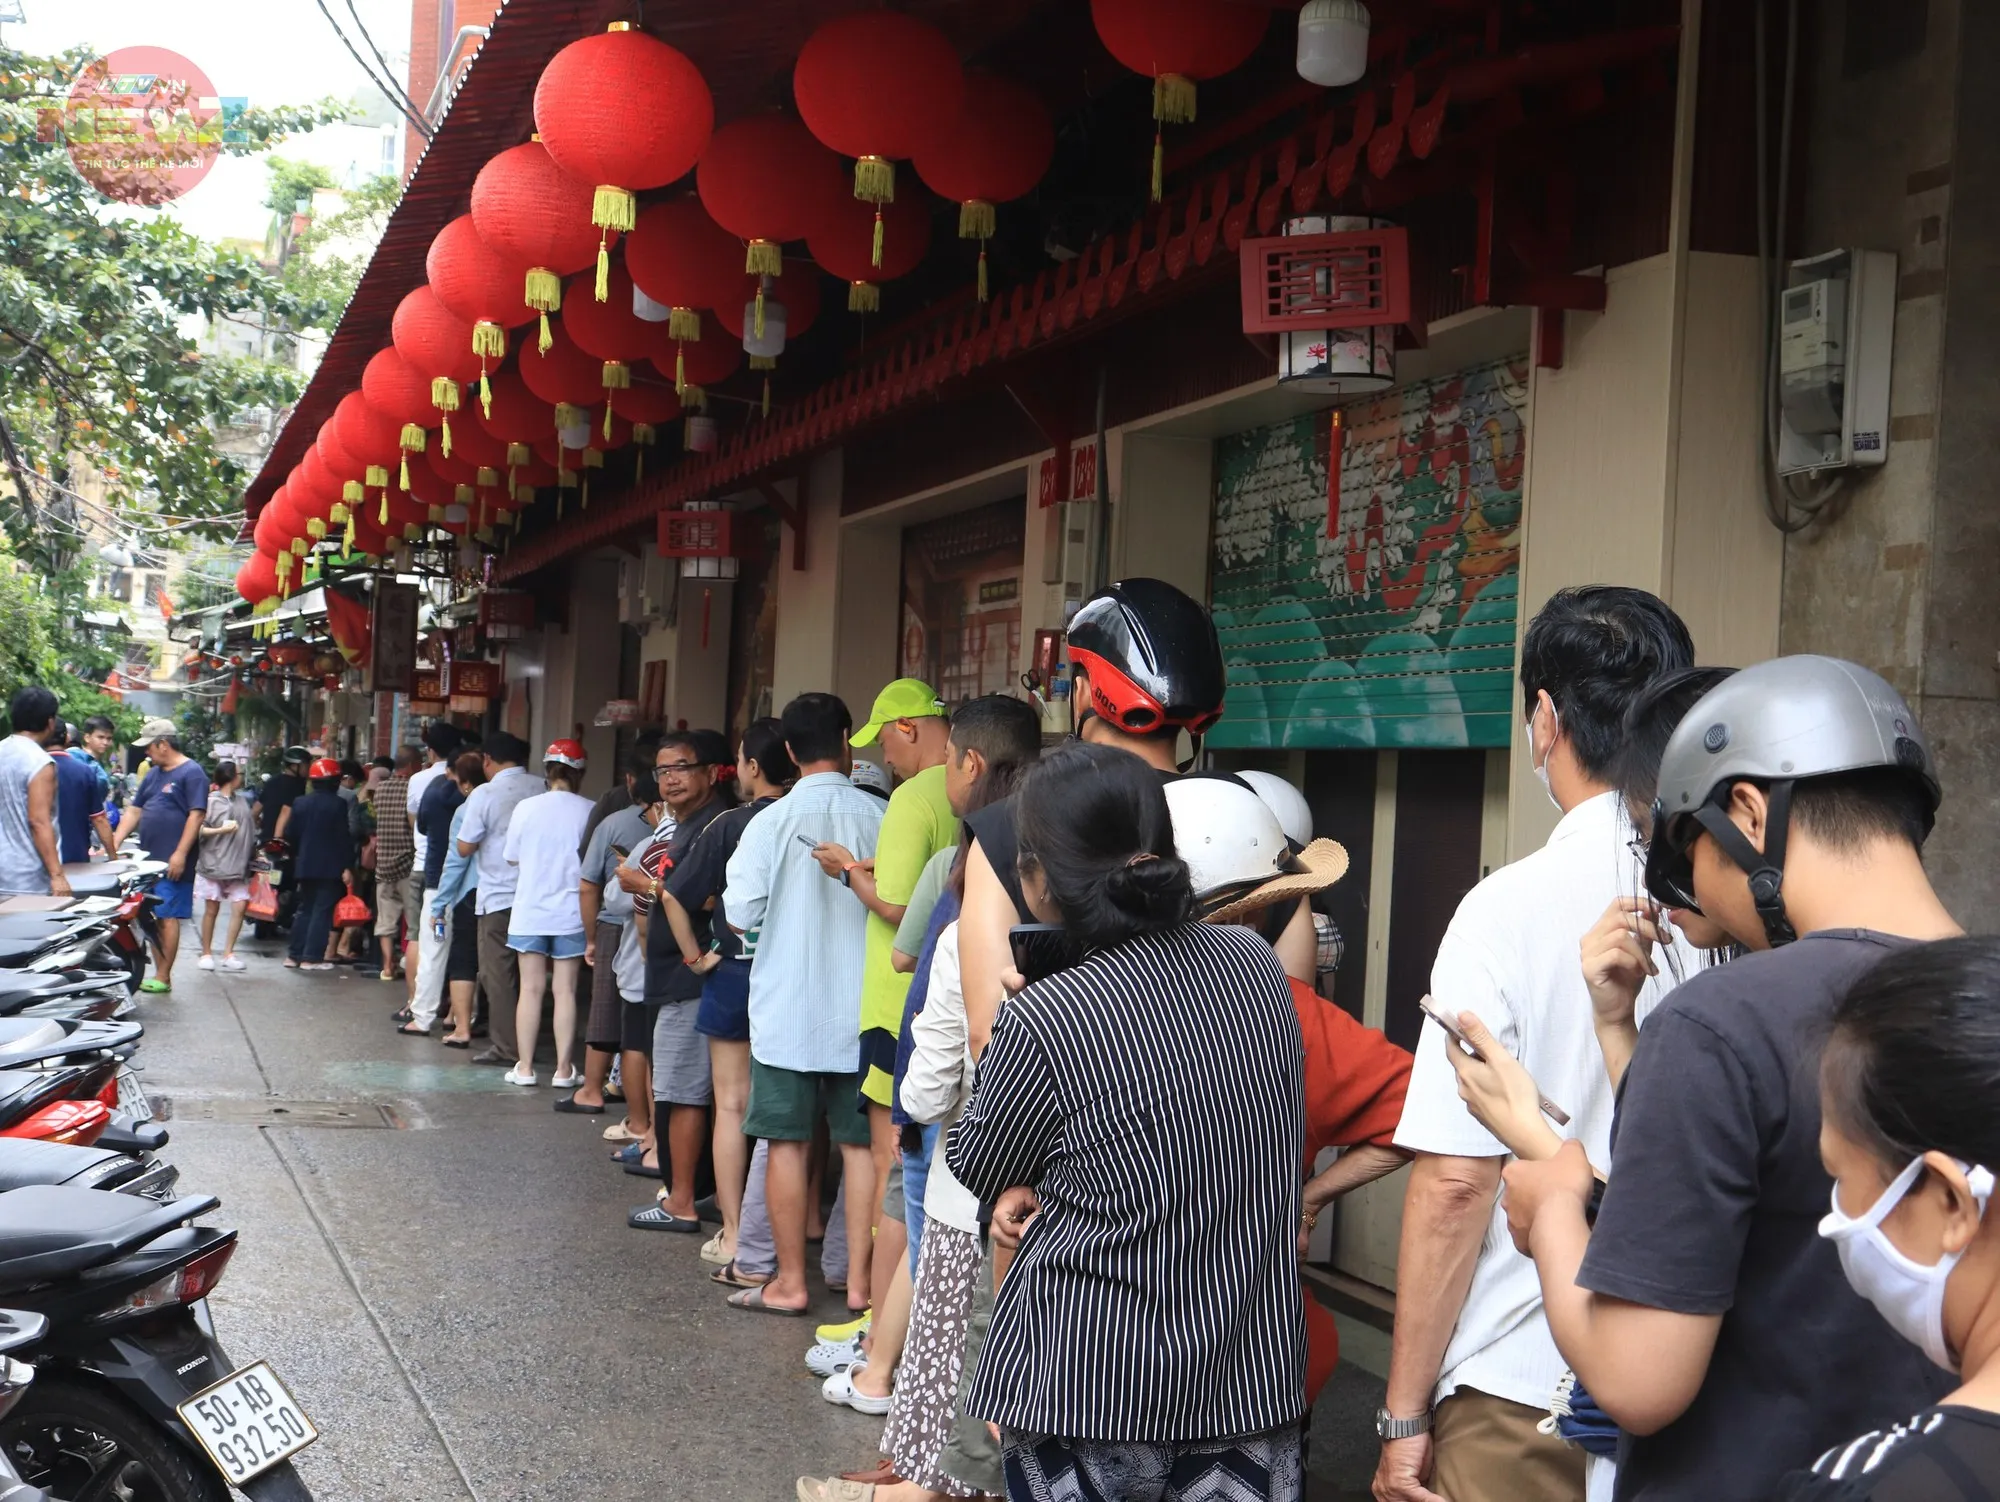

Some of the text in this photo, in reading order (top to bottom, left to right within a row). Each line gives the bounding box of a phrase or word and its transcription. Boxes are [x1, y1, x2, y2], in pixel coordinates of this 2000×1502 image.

[88, 1158, 135, 1180] HONDA
[176, 1355, 209, 1376] HONDA
[194, 1374, 274, 1434] 50-AB
[217, 1406, 305, 1475] 932.50
